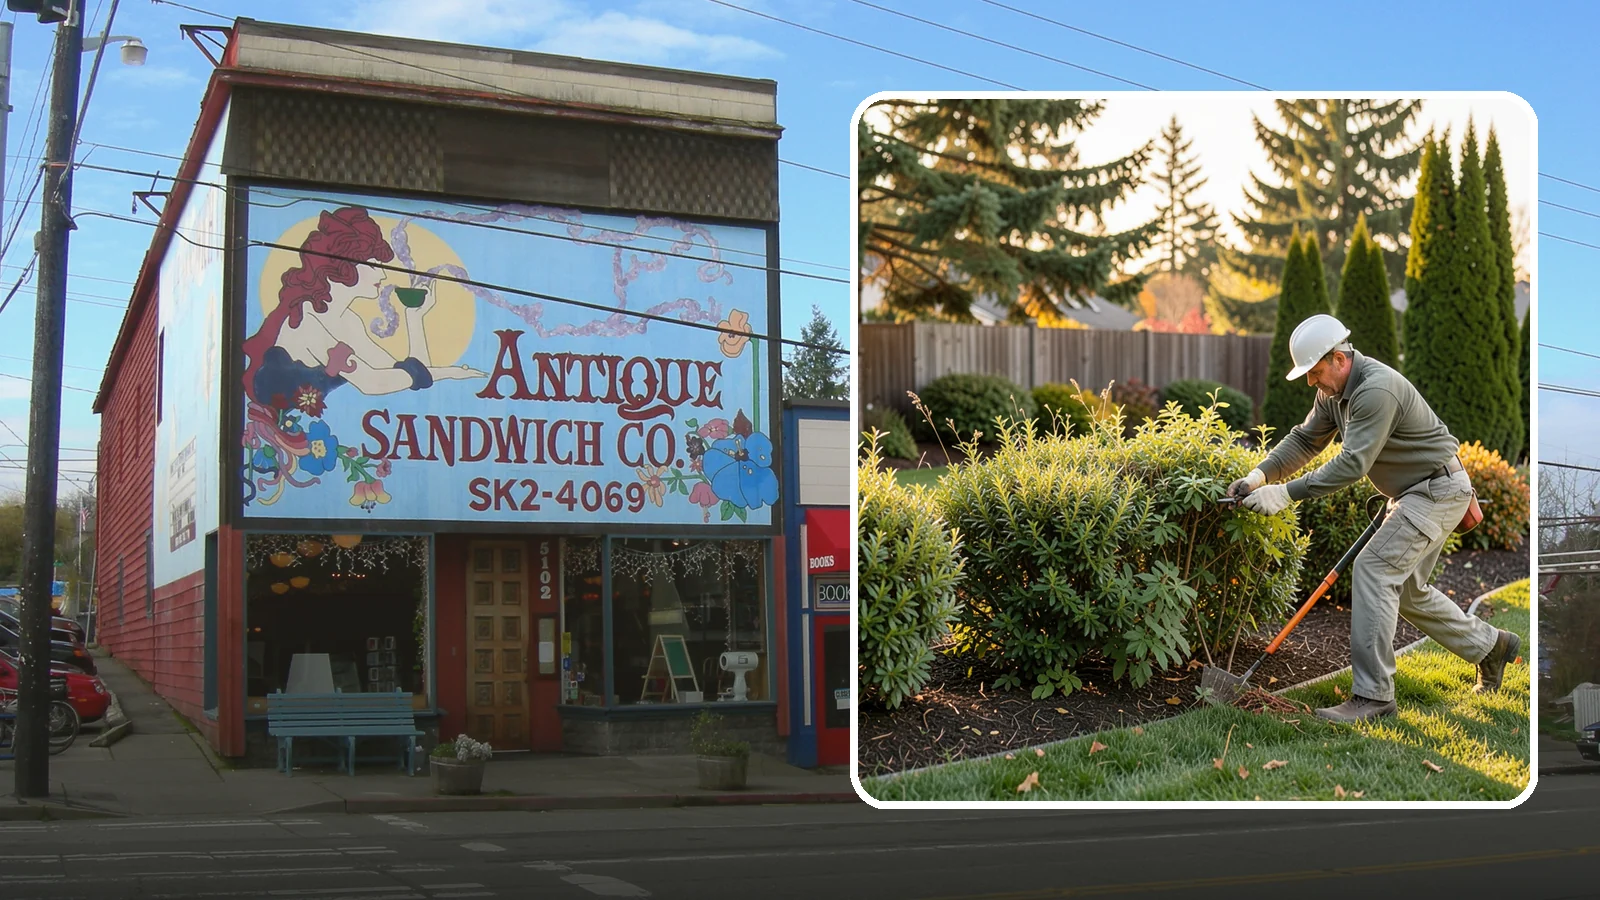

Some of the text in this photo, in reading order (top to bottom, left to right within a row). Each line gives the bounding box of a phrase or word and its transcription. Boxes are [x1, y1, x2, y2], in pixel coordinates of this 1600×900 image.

[476, 329, 723, 421] ANTIQUE
[361, 408, 685, 469] SANDWICH CO.
[468, 477, 646, 514] SK2-4069
[540, 541, 552, 600] 5102
[809, 555, 835, 569] BOOKS
